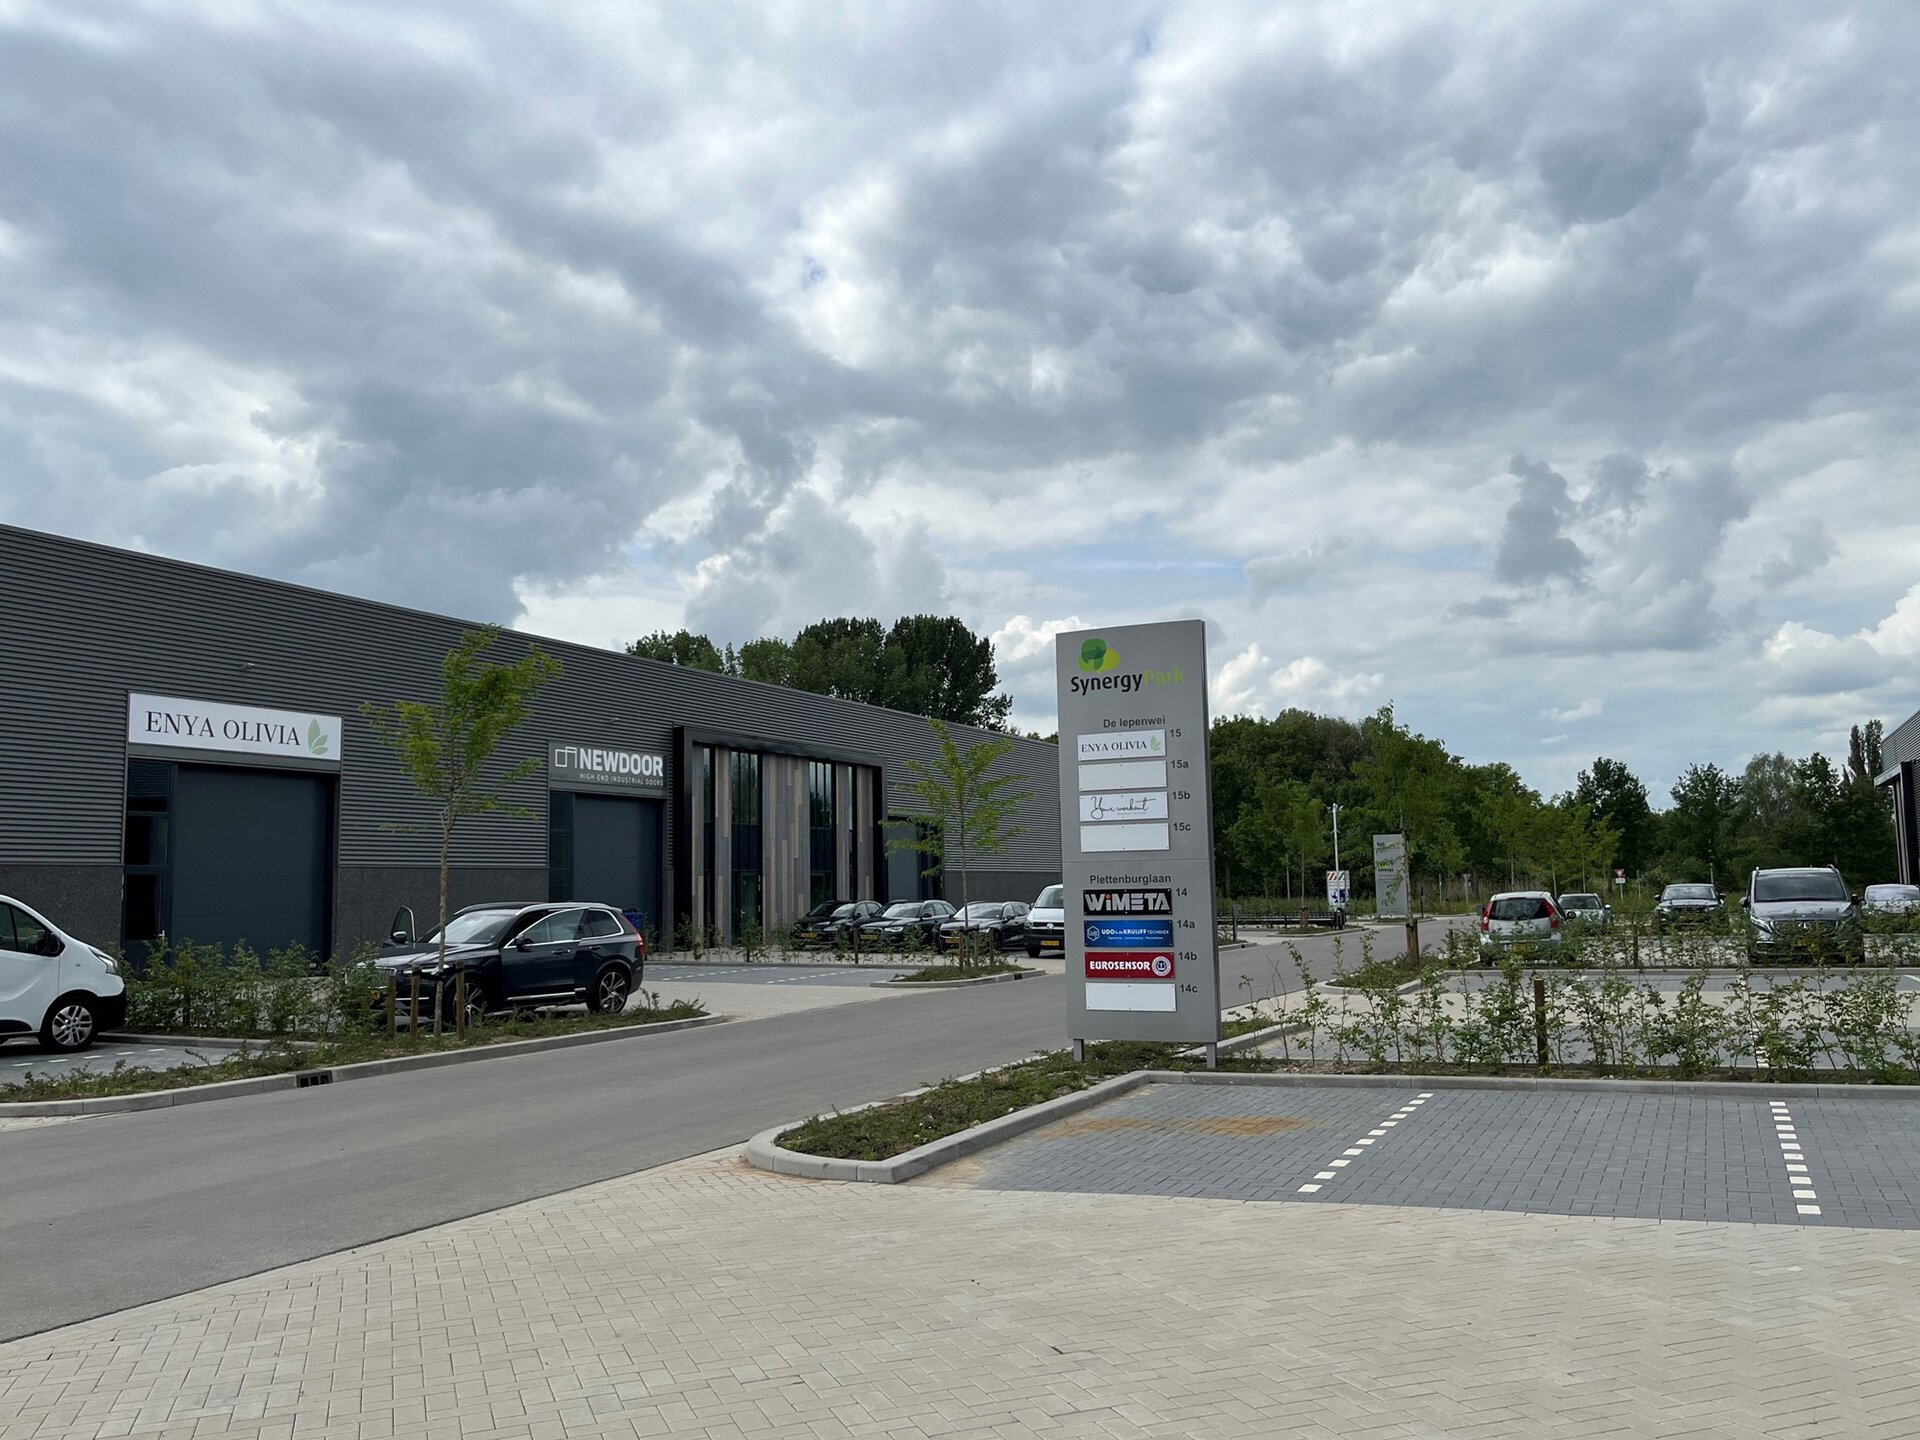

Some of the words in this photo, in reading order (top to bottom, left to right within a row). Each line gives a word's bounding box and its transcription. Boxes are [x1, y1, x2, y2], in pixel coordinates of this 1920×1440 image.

[145, 711, 215, 738] ENYA
[223, 720, 300, 746] OLIVIA
[1103, 719, 1117, 729] De
[1169, 729, 1182, 738] 15
[1081, 743, 1109, 753] ENYA
[1111, 740, 1147, 751] OLIVIA
[580, 747, 664, 777] NEWDOOR
[1170, 760, 1189, 769] 15a
[580, 773, 609, 782] HIGH-END
[610, 776, 644, 785] INDUSTRIAL
[645, 779, 664, 787] DOORS
[1171, 791, 1191, 800] 15b
[1173, 822, 1191, 831] 15c
[1089, 874, 1172, 885] Plettenburglaan
[1175, 888, 1188, 897] 14
[1176, 920, 1195, 929] 14a
[1177, 952, 1197, 961] 14b
[1089, 960, 1151, 971] EUROSENSOR
[1179, 984, 1198, 993] 14c
